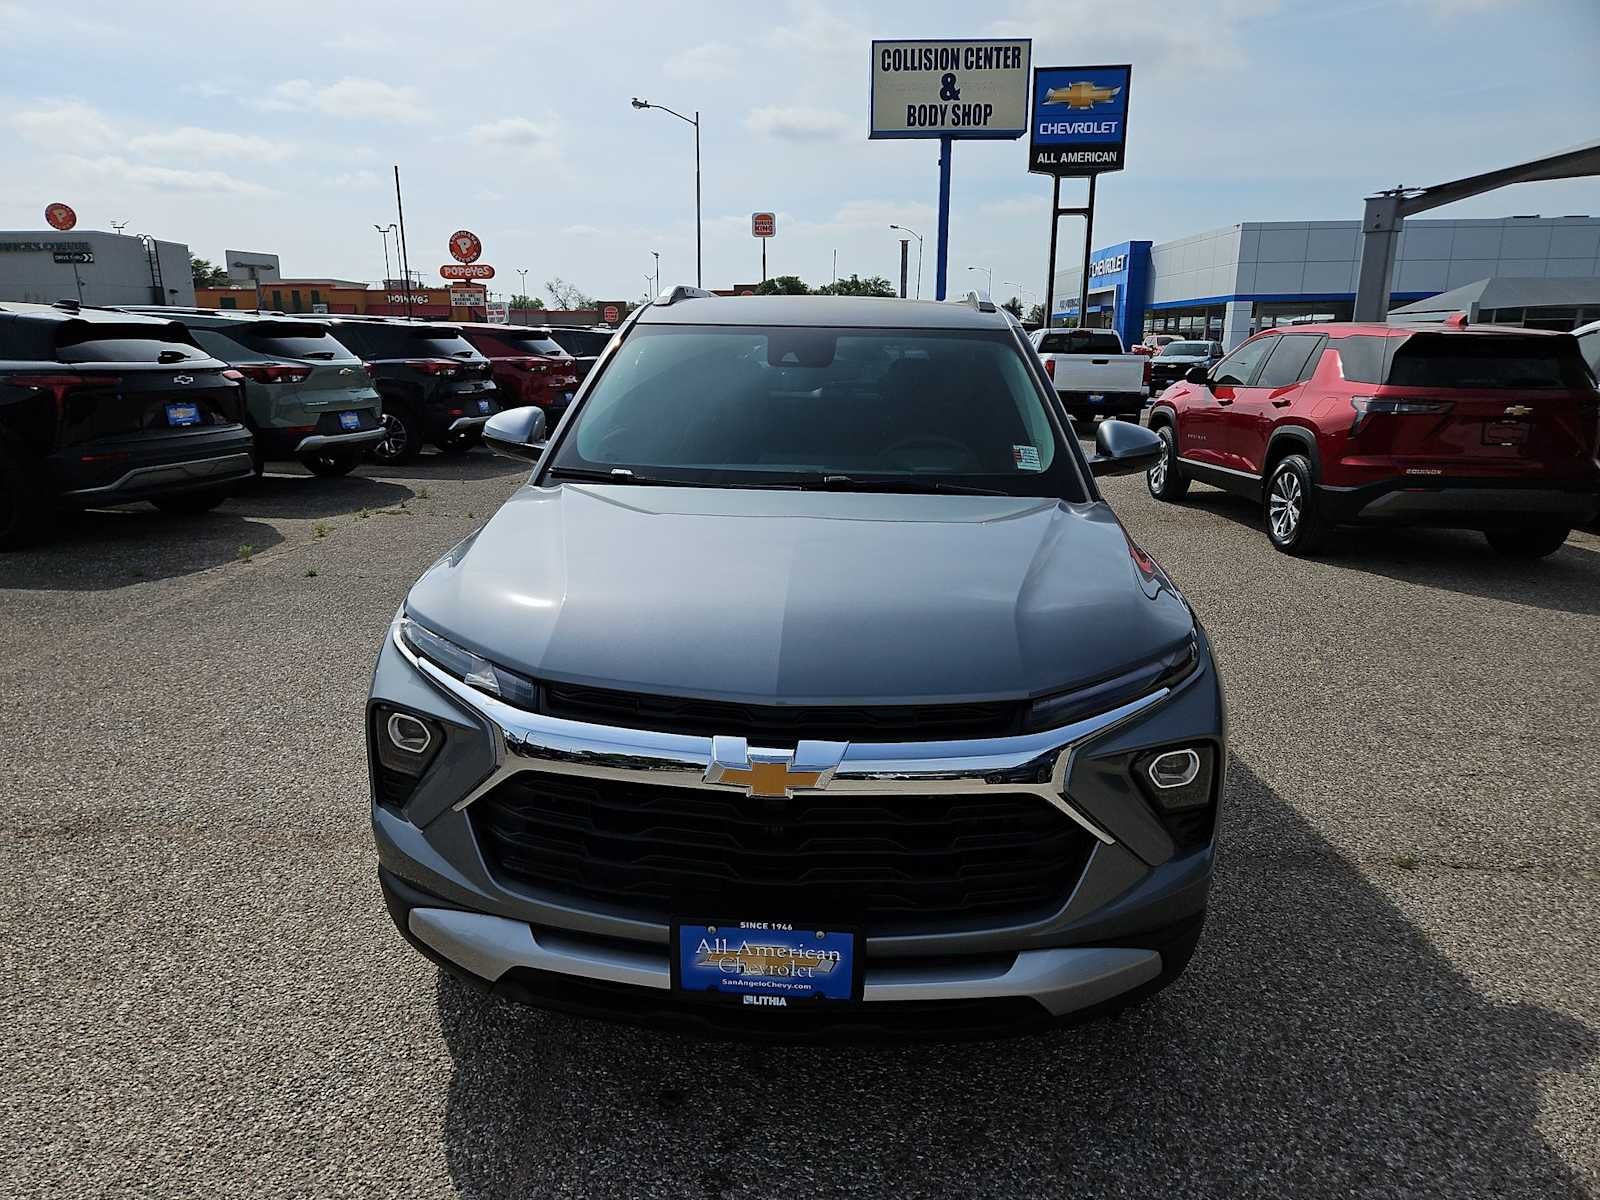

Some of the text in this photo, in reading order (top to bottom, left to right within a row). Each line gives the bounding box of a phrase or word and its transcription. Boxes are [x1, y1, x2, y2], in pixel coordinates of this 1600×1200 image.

[881, 46, 1021, 72] COLLISION CENTER
[939, 73, 961, 101] &
[906, 103, 993, 127] BODY SHOP
[1039, 121, 1118, 135] CHEVROLET
[1037, 151, 1118, 164] ALL AMERICAN
[1092, 254, 1125, 277] CHEVROLET
[740, 921, 793, 931] SINCE 1946
[695, 938, 840, 961] All American
[718, 956, 816, 979] Chevrolet
[722, 978, 812, 991] SanAngeloChevy.com
[753, 995, 787, 1007] LITHIA
